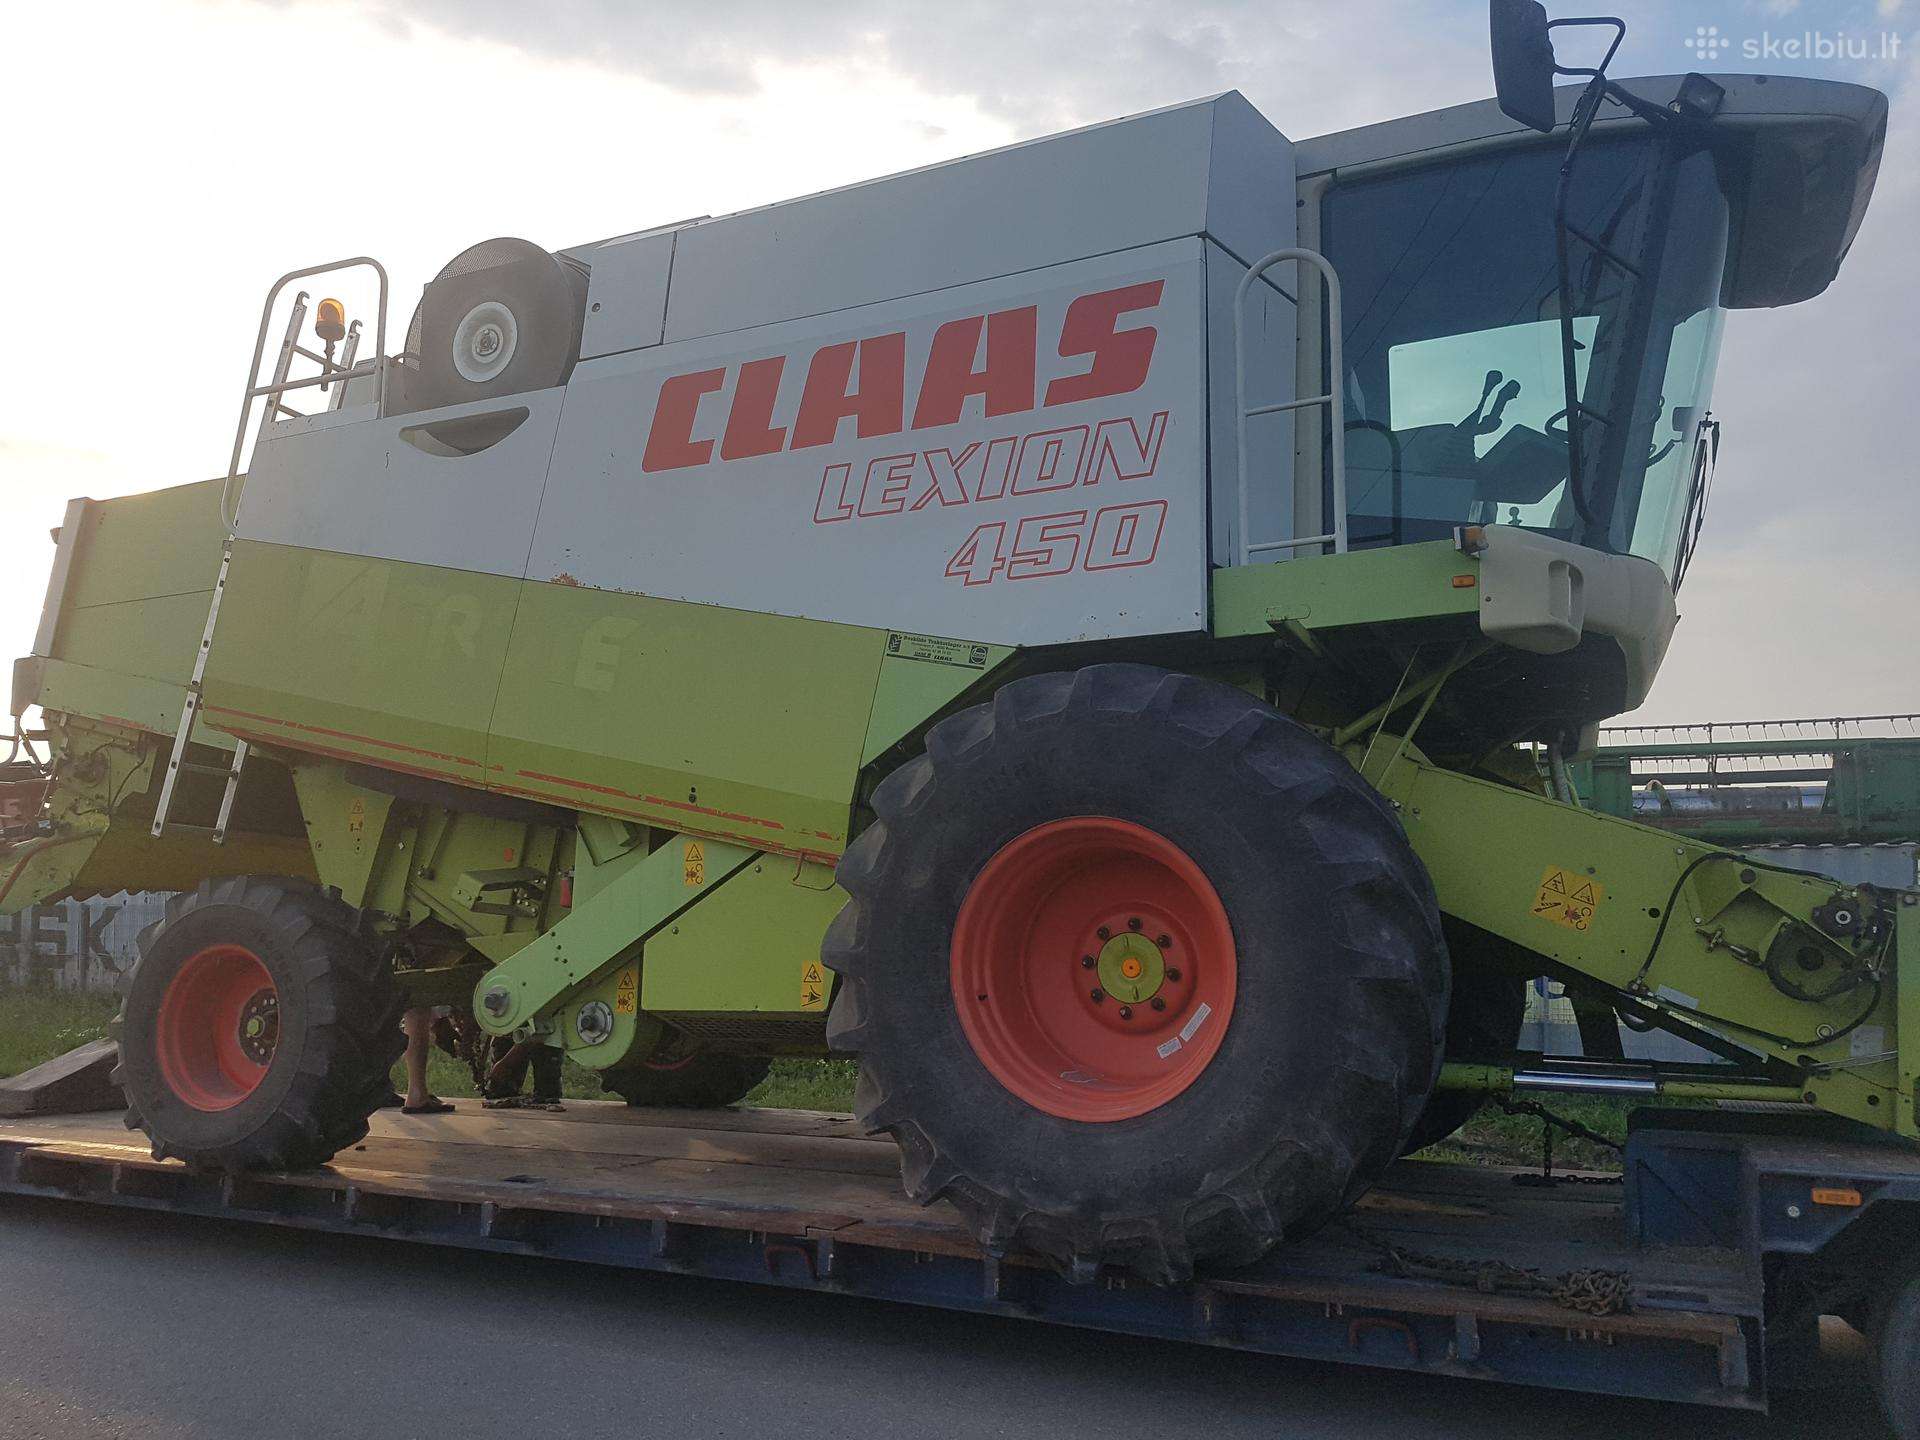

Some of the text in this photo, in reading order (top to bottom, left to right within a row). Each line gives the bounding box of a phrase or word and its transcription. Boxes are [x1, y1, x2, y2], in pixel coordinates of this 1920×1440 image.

[641, 279, 1166, 473] CLAAS
[813, 411, 1170, 524] LEXION
[944, 500, 1168, 587] 450
